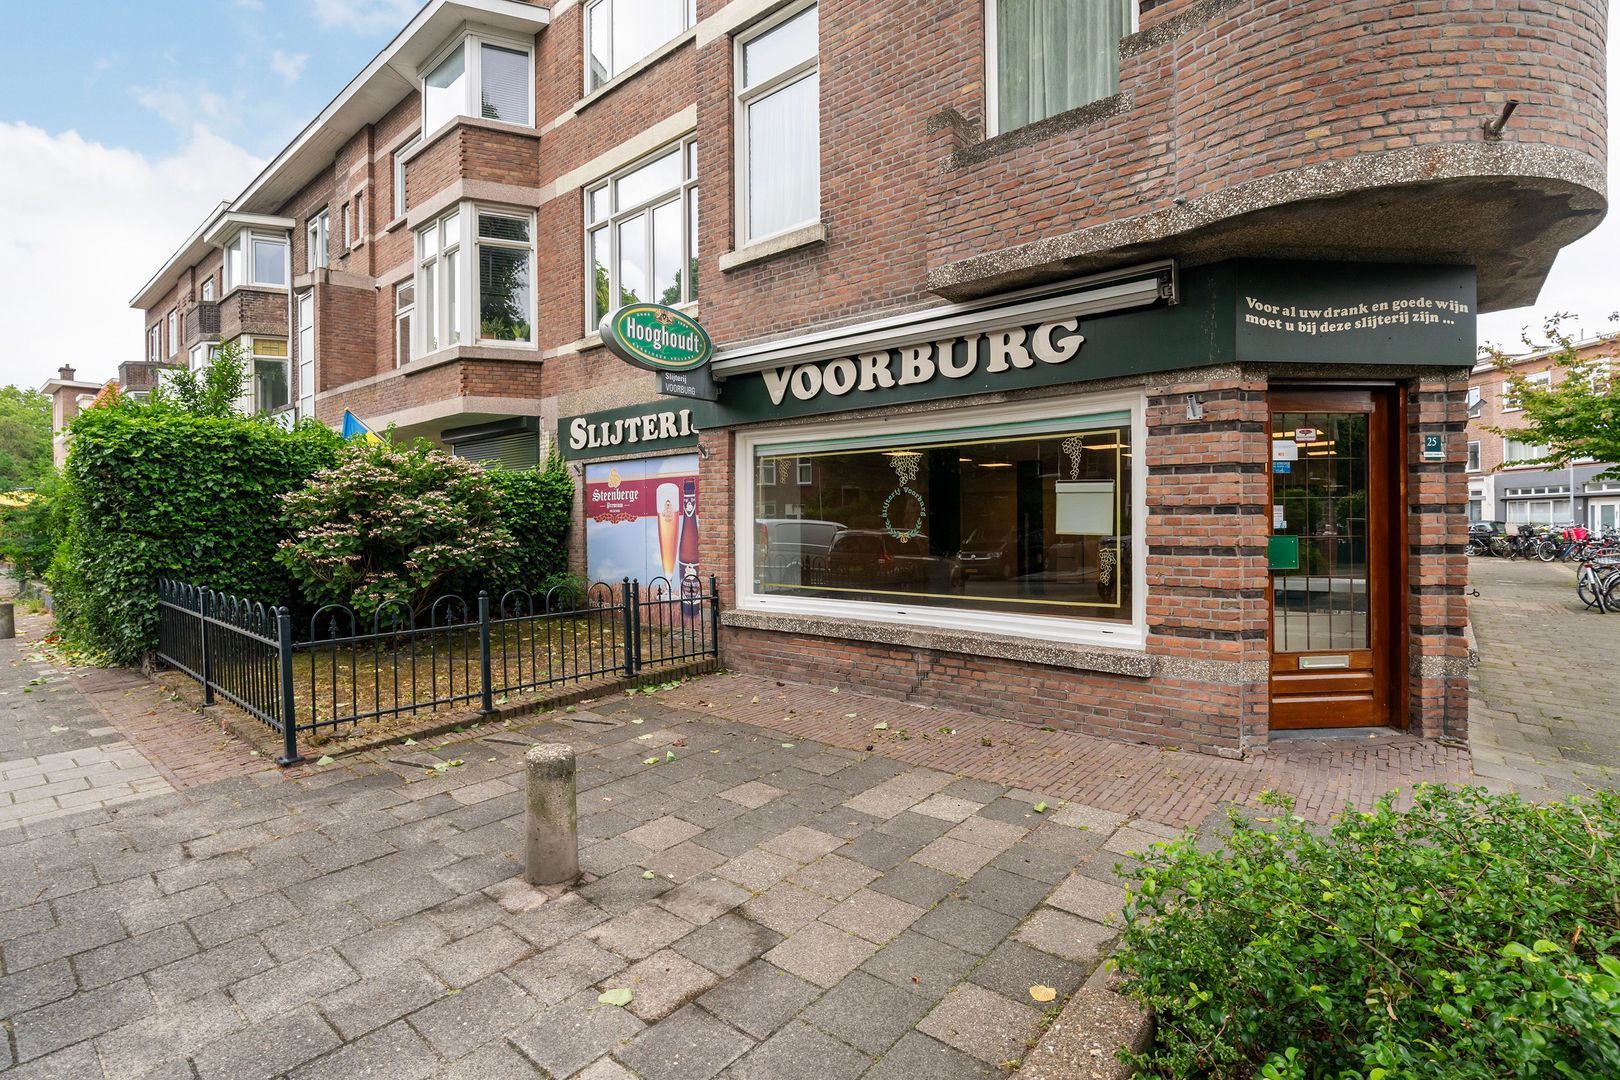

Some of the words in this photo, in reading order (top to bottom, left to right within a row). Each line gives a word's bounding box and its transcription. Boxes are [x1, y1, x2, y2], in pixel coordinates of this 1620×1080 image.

[1245, 296, 1280, 315] Voor
[1282, 306, 1297, 318] al
[1299, 309, 1322, 319] uw
[1323, 303, 1369, 319] drank
[1371, 301, 1389, 312] en
[1392, 297, 1433, 312] goede
[1435, 300, 1469, 314] wijn
[626, 315, 700, 354] Hooghoudt
[1245, 313, 1282, 330] moet
[1285, 322, 1295, 332] u
[1298, 321, 1317, 336] bij
[1319, 321, 1352, 333] deze
[1354, 311, 1409, 329] slijterij
[1412, 311, 1439, 325] zijn
[760, 316, 1086, 406] VOORBURG
[665, 372, 687, 384] Slijterij
[665, 382, 696, 396] VOORBURG
[569, 408, 699, 450] SLIJTERI
[1426, 436, 1437, 447] 25
[591, 488, 639, 503] Steenberge
[882, 487, 901, 518] Slijterij
[903, 486, 927, 517] Voorburg
